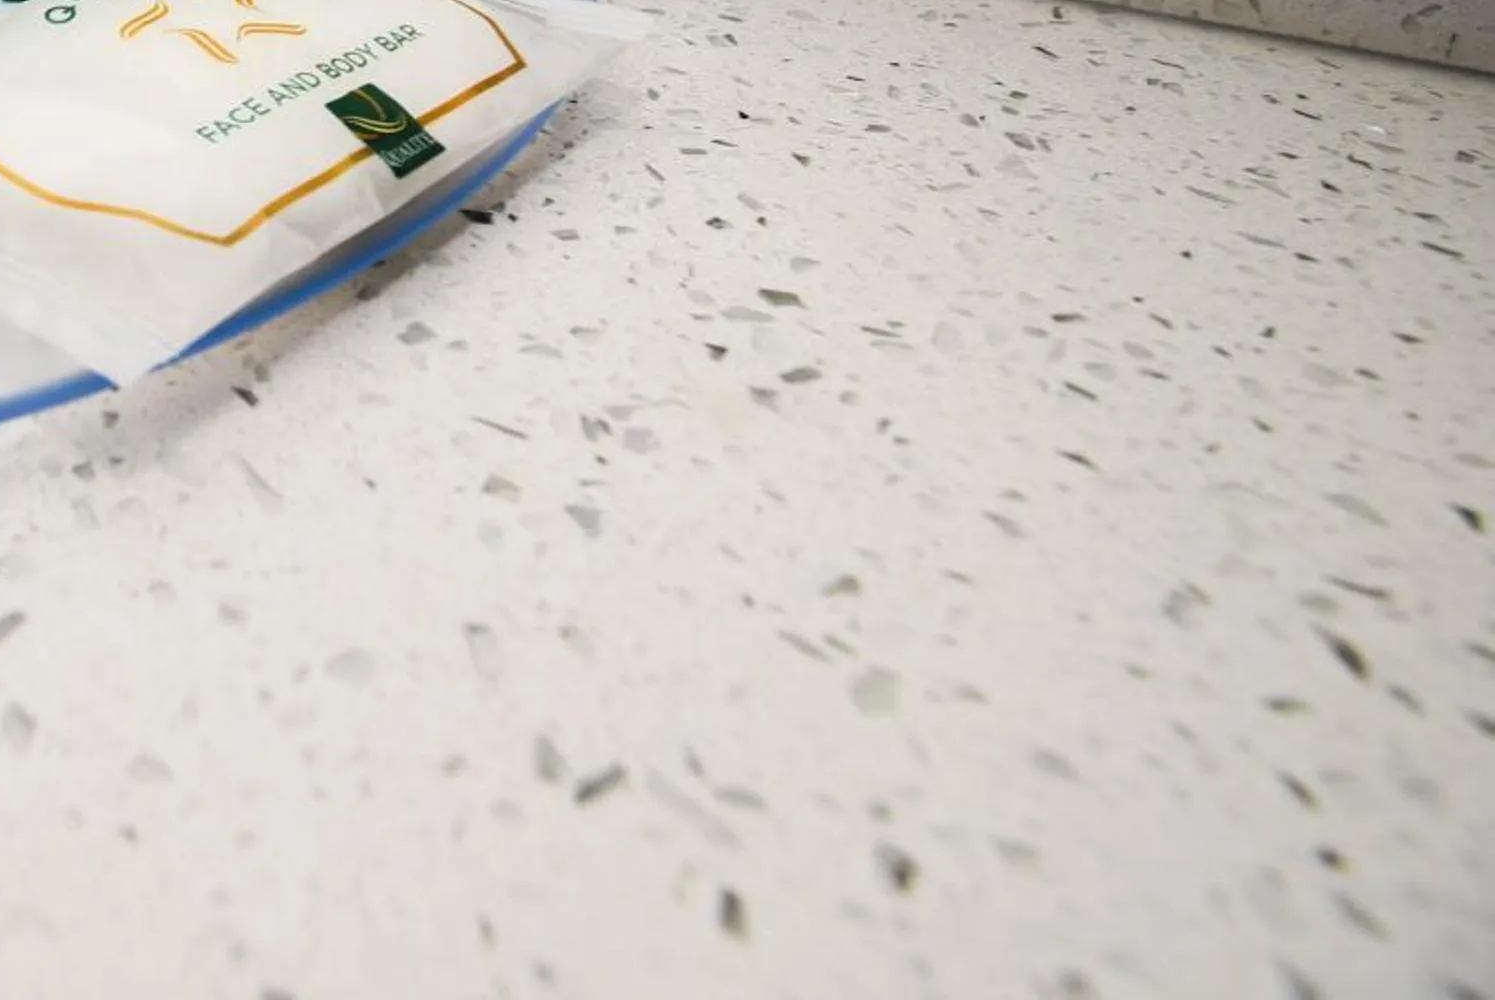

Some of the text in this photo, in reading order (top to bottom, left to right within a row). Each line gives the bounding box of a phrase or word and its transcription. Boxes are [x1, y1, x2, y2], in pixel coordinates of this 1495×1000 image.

[44, 5, 77, 24] Q
[195, 23, 424, 144] FACE AND BODY BAR
